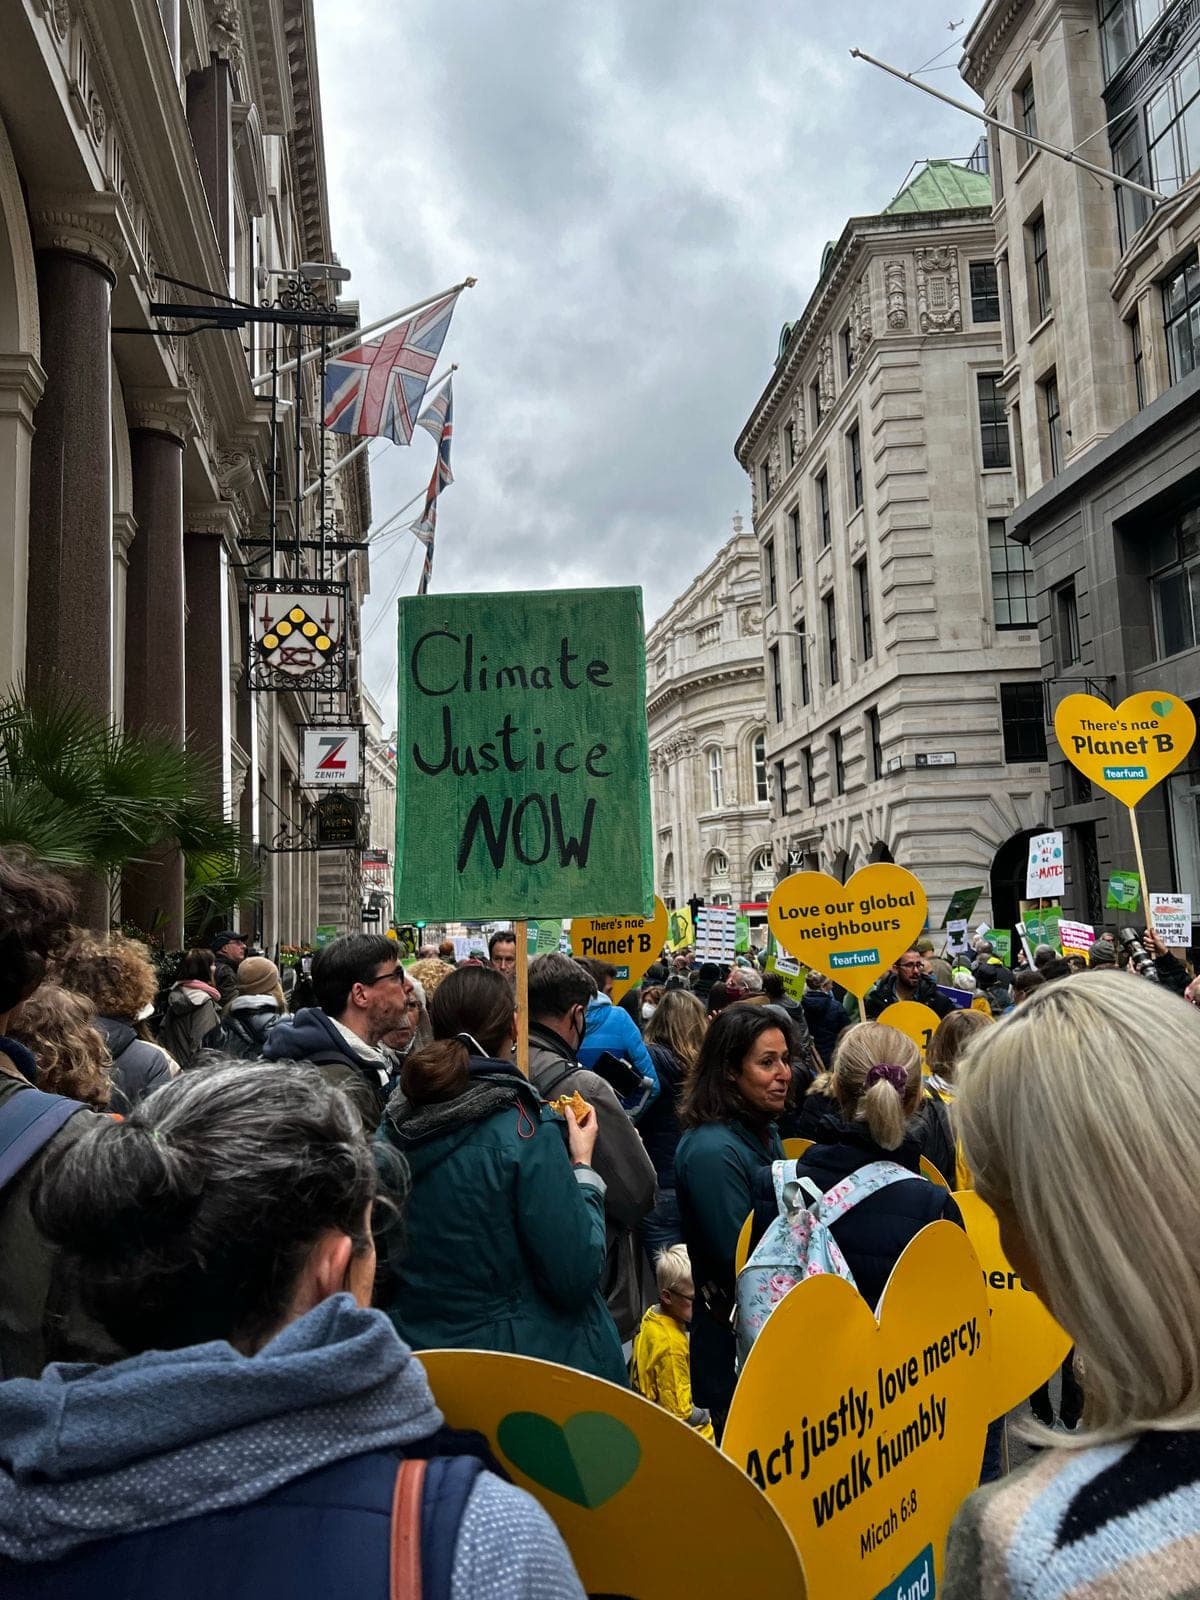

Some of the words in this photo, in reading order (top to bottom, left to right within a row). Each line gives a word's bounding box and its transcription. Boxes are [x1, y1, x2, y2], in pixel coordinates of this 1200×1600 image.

[412, 630, 613, 696] Climate
[1080, 719, 1128, 731] There's
[1131, 720, 1159, 730] nae
[413, 705, 613, 777] Justice
[1071, 735, 1148, 754] Planet
[1152, 733, 1174, 752] B
[315, 771, 346, 779] ZENITH
[1106, 768, 1145, 778] tearfund
[457, 792, 597, 874] NOW
[778, 905, 821, 920] Love
[825, 901, 855, 914] our
[859, 891, 915, 915] global
[590, 918, 622, 931] There's
[624, 918, 644, 928] nae
[800, 918, 900, 941] neighbours
[581, 935, 634, 955] Planet
[637, 933, 651, 953] B
[832, 951, 876, 966] tearfund
[746, 1430, 794, 1491] Act
[800, 1386, 874, 1480] justly,
[877, 1356, 919, 1409] love
[923, 1316, 981, 1377] mercy,
[812, 1450, 873, 1528] walk
[876, 1393, 947, 1478] humbly
[859, 1507, 898, 1559] Micah
[900, 1488, 918, 1522] 6:8
